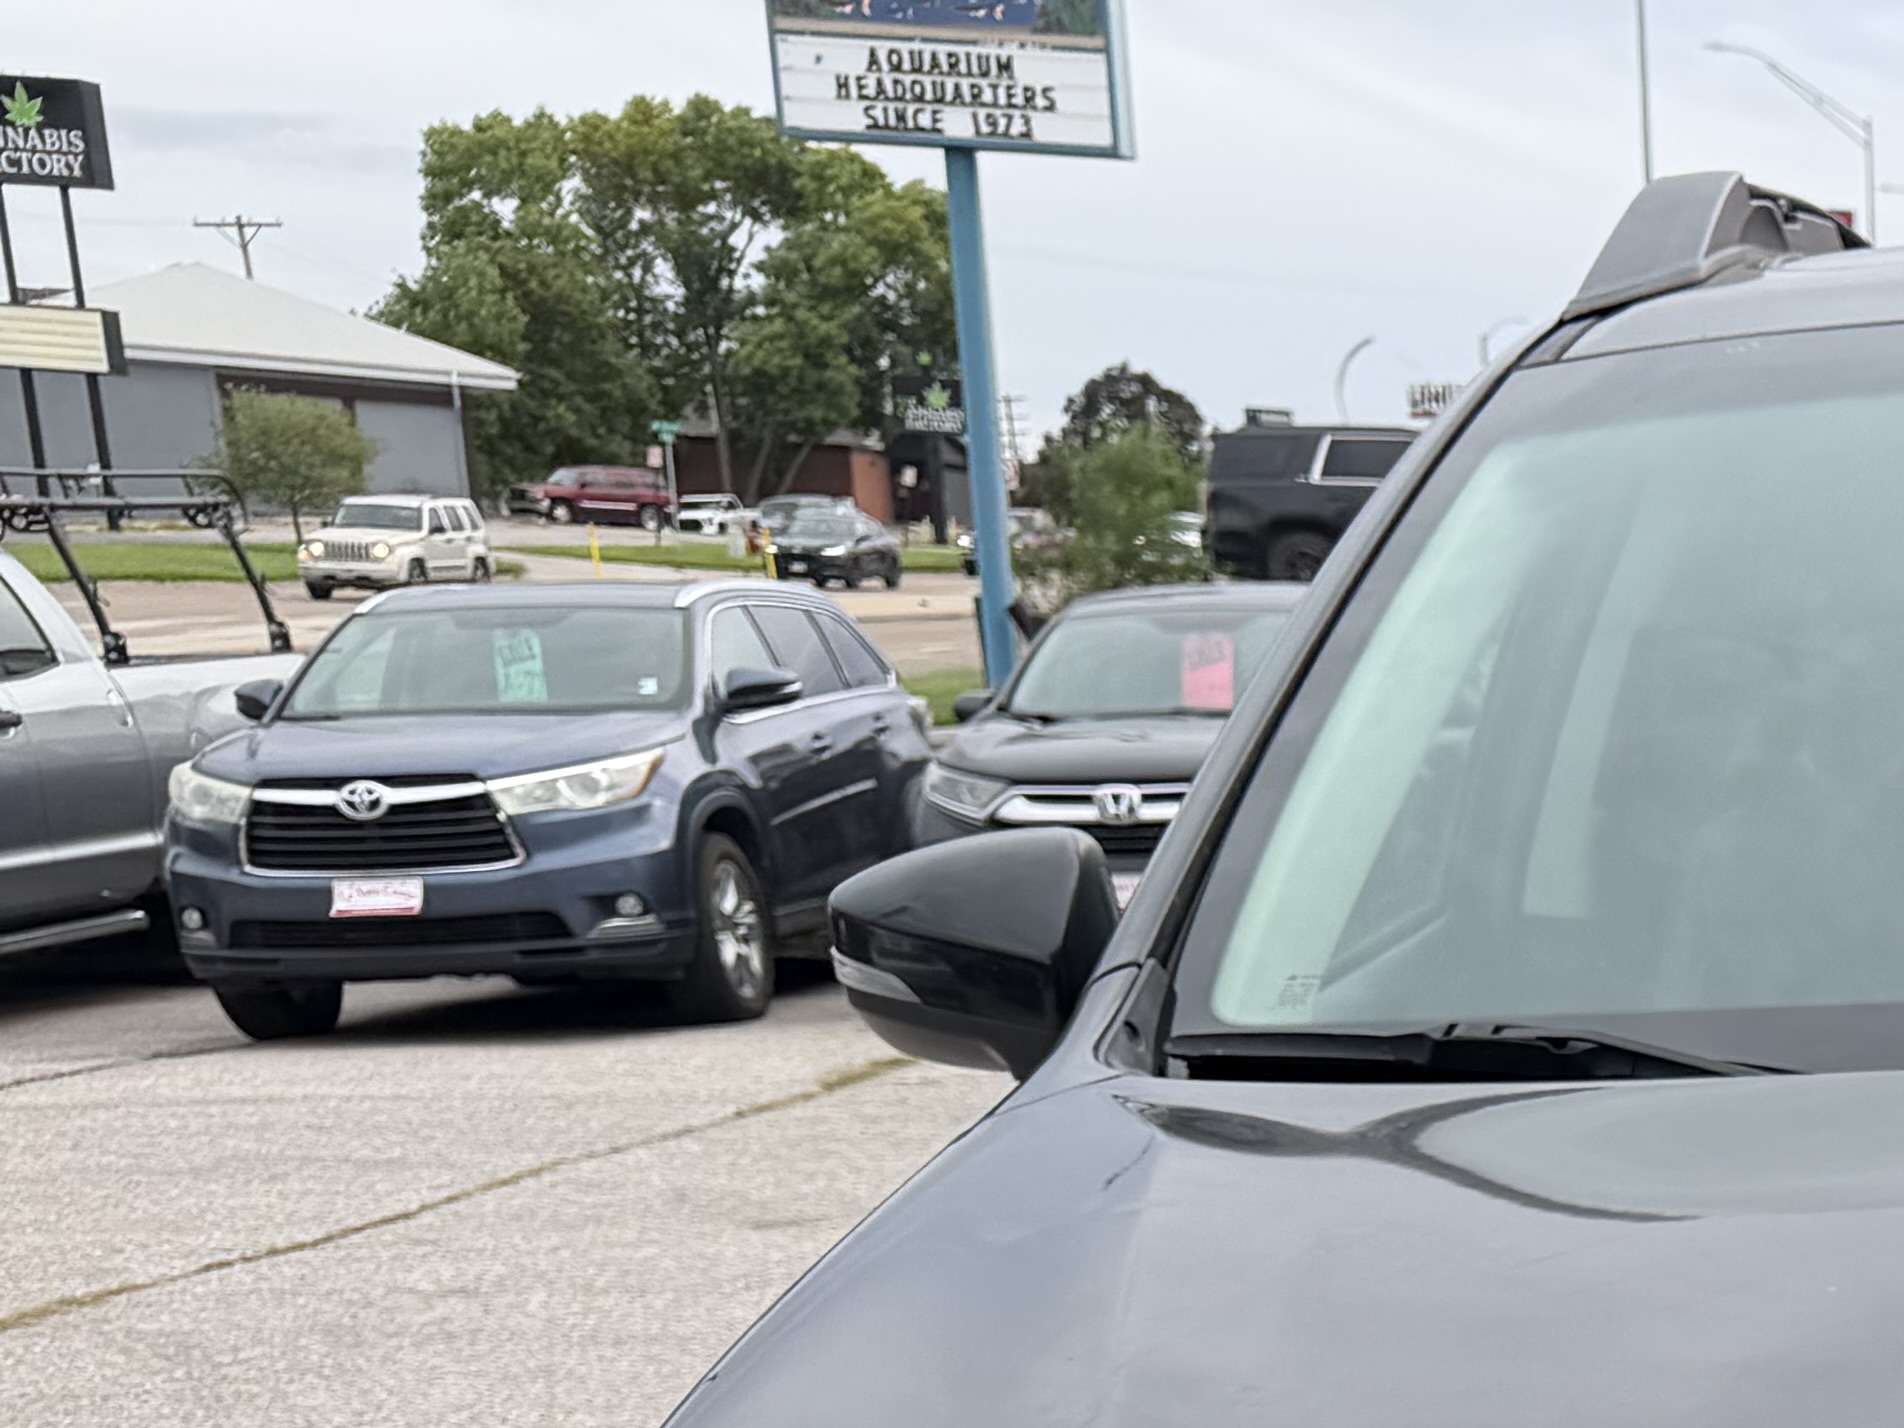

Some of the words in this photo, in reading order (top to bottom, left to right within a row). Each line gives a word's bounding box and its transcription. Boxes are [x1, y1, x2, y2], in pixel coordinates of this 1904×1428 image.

[866, 47, 1016, 79] AQUARIUM
[834, 74, 1058, 112] HEADQUARTERS
[862, 104, 944, 133] SINCE
[971, 110, 1034, 138] 1973
[0, 149, 84, 177] CTORY
